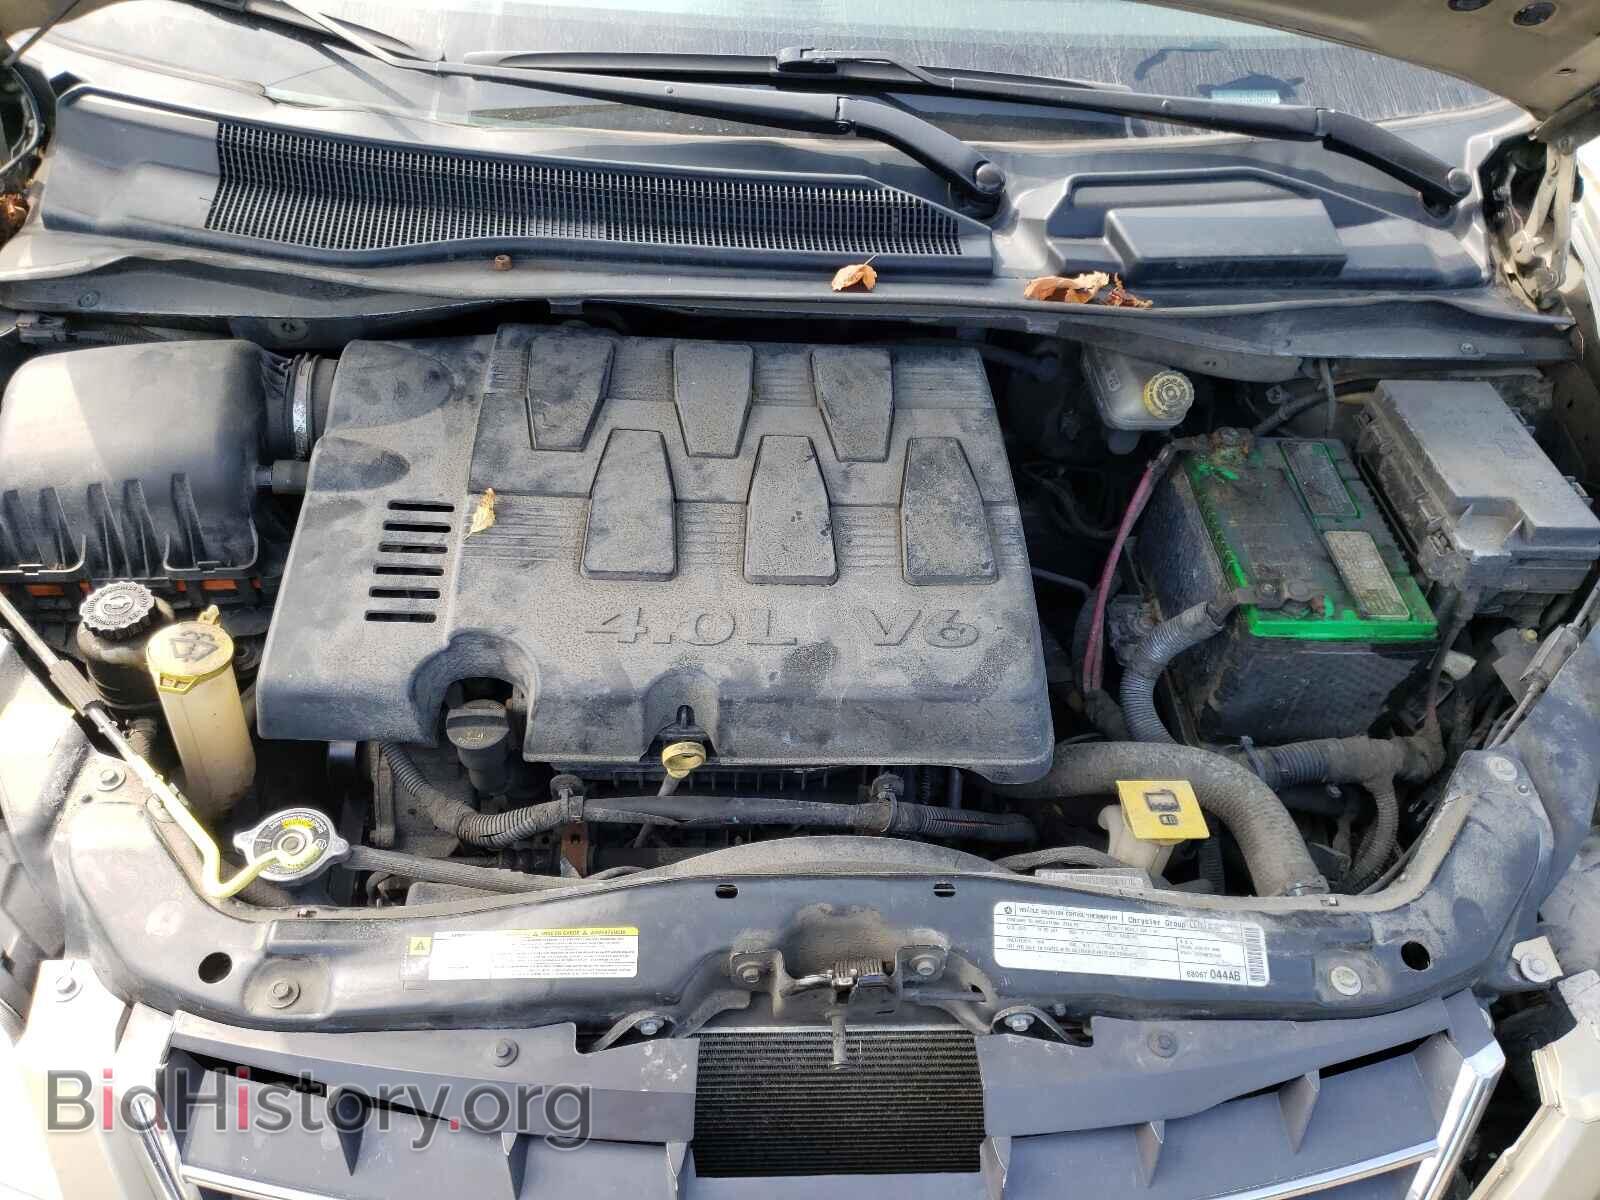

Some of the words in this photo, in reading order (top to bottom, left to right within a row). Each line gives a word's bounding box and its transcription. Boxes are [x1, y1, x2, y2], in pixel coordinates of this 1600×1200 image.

[584, 607, 798, 646] 4.0L
[870, 607, 980, 648] V6
[1164, 919, 1186, 928] Group
[1209, 968, 1241, 981] 044AB
